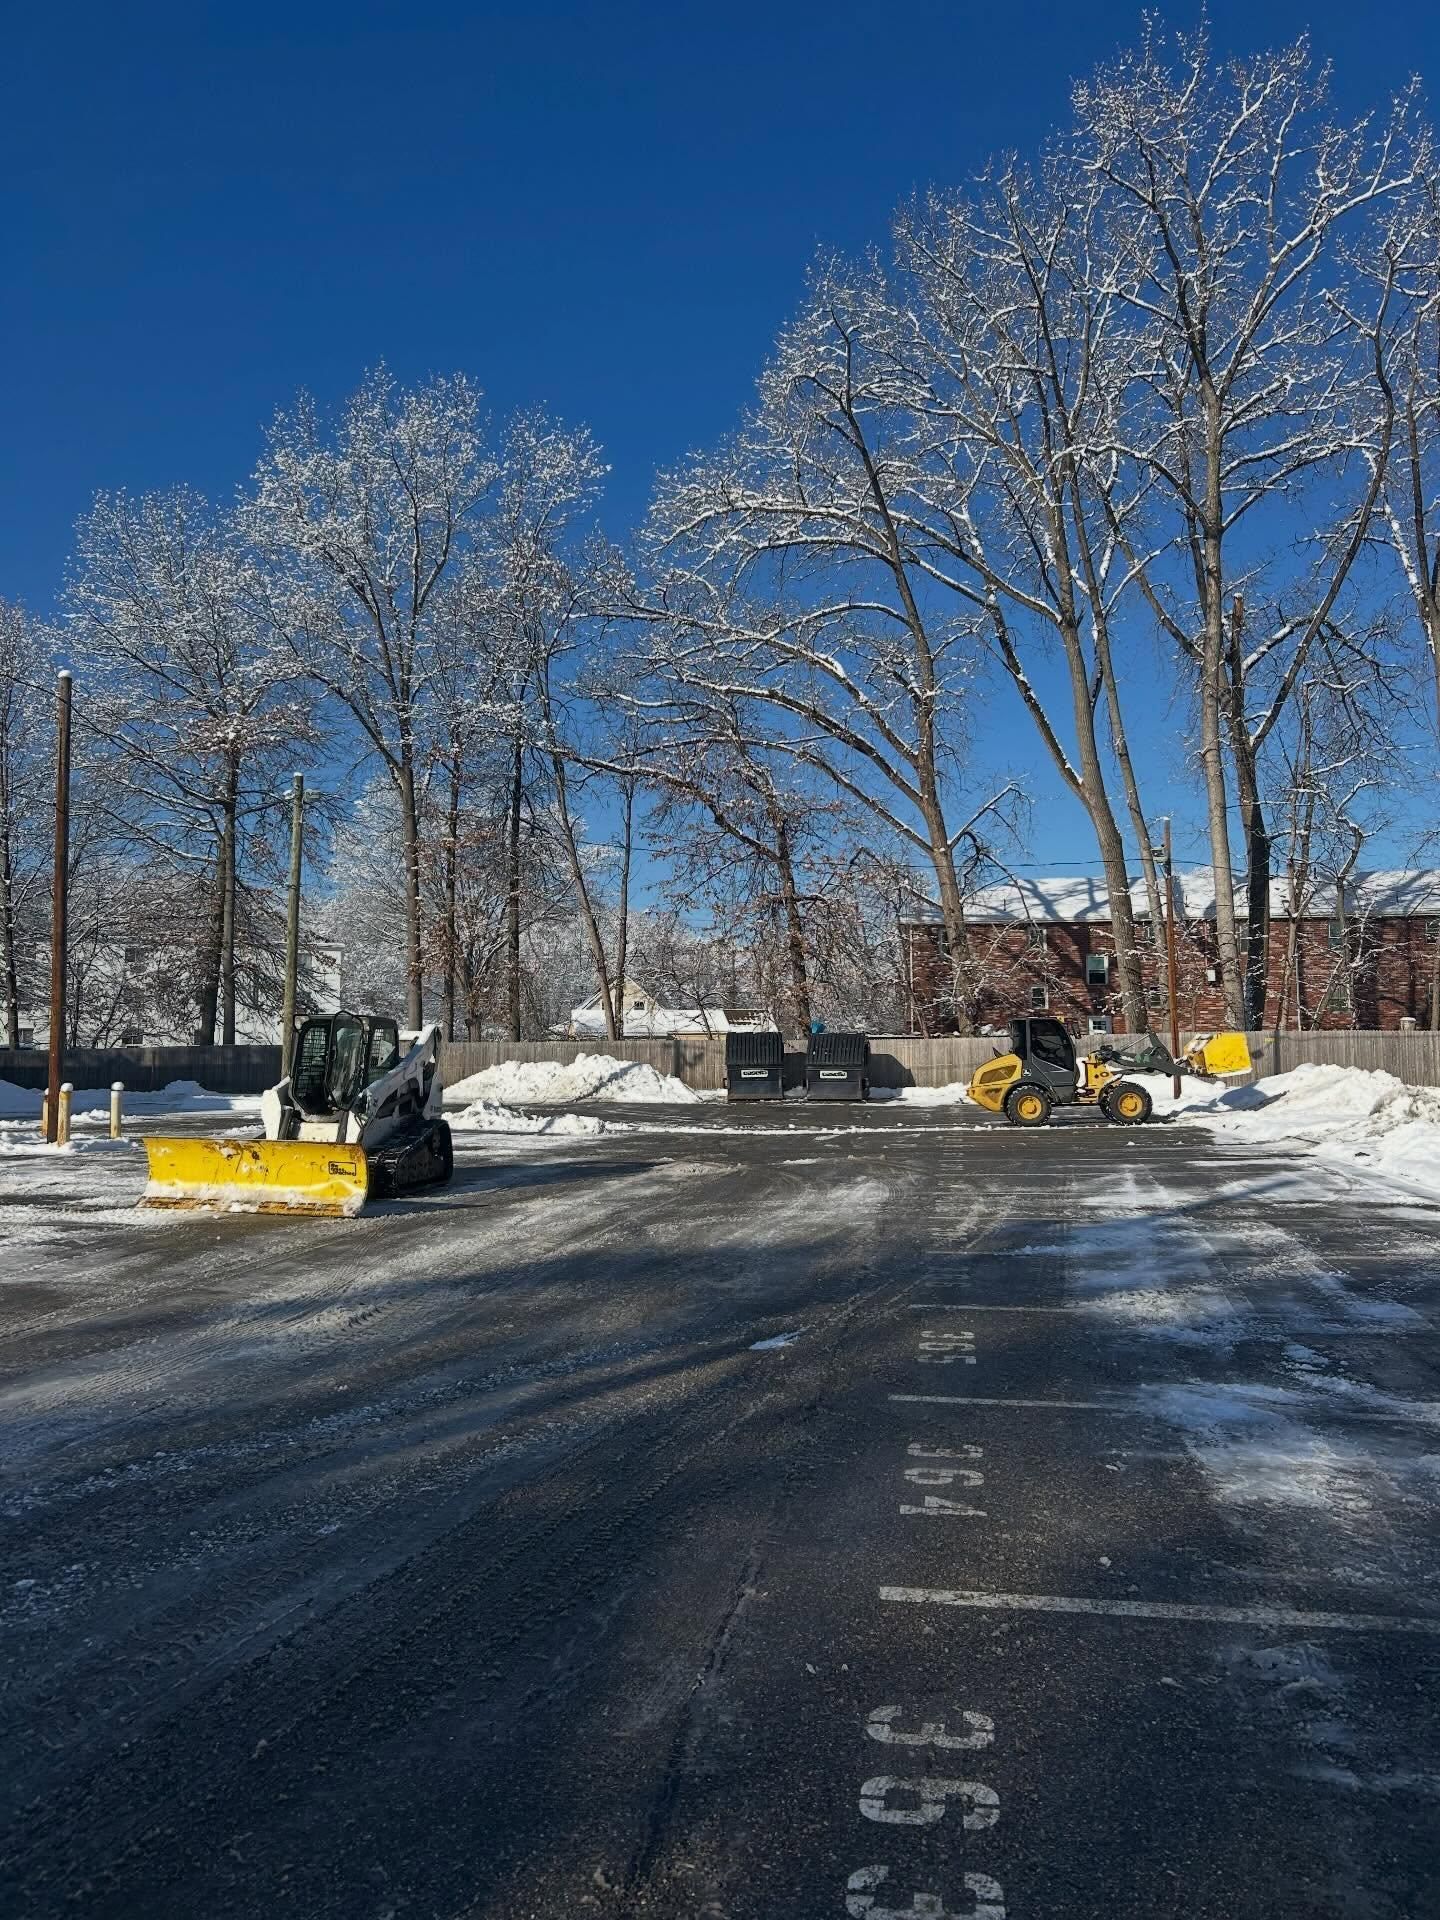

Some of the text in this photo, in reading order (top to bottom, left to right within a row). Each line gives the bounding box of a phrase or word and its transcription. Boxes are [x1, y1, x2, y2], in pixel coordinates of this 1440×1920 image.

[917, 1330, 976, 1364] 365
[900, 1443, 987, 1516] 364
[846, 1705, 1006, 1920] 363
